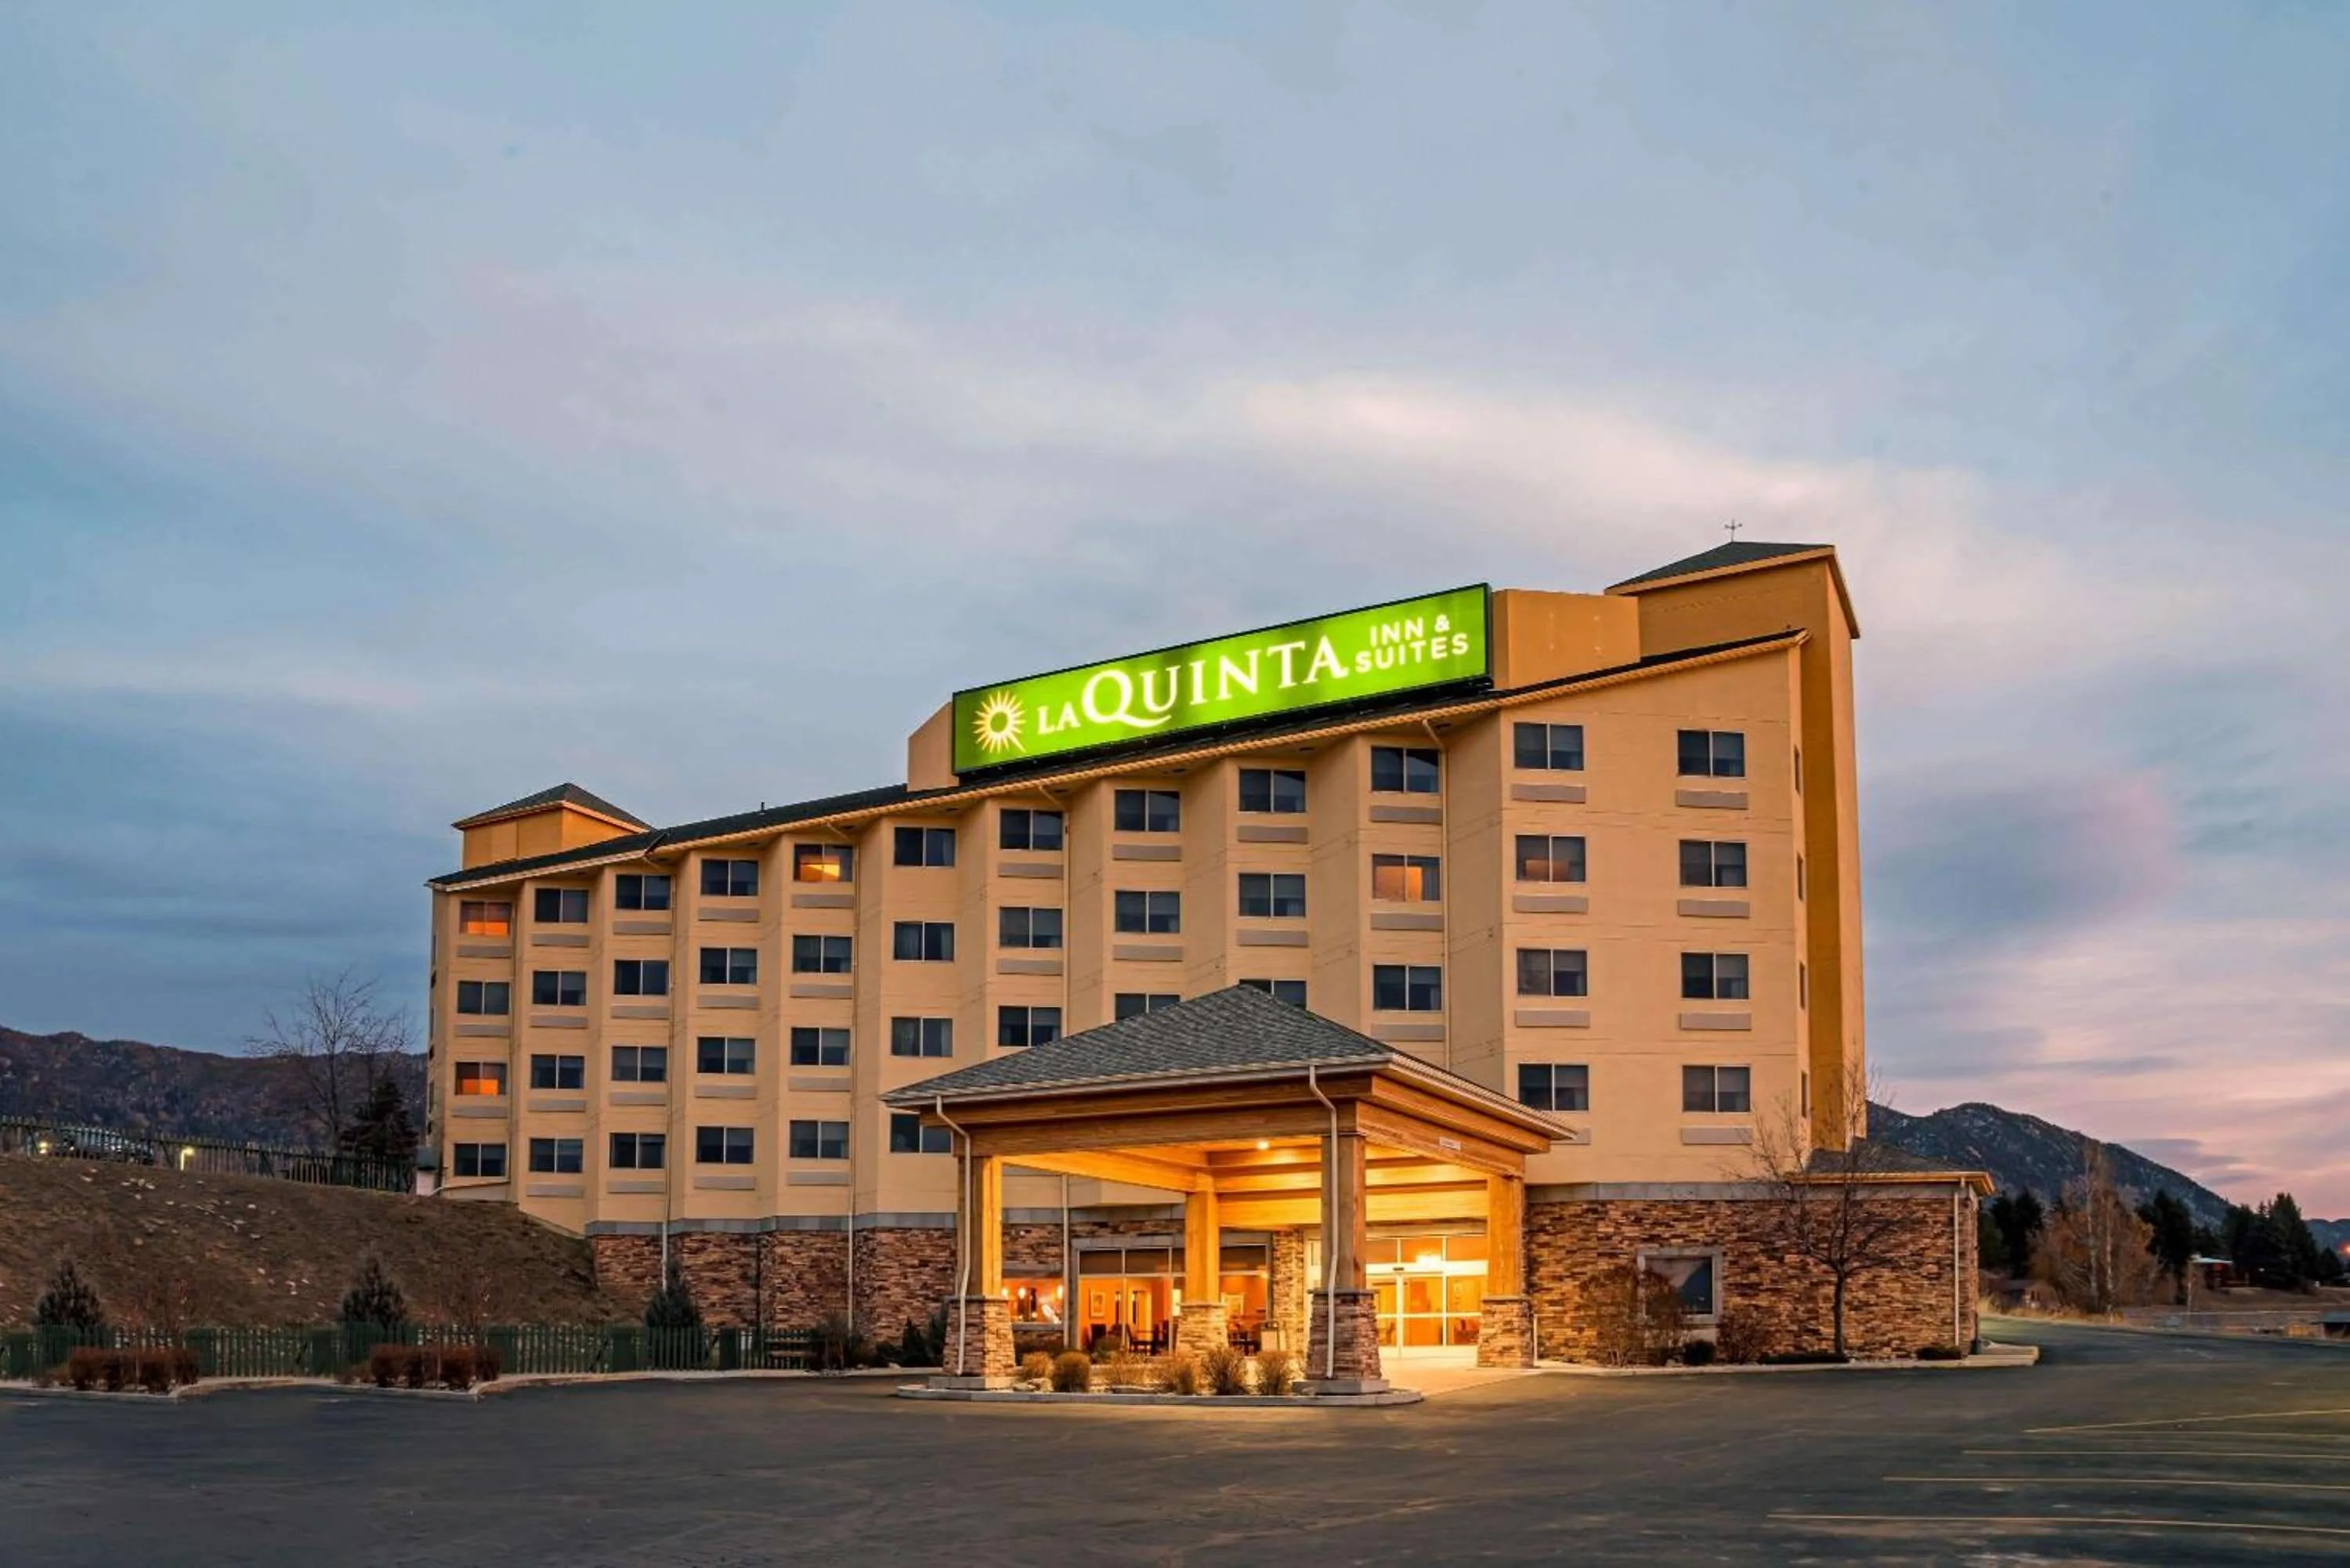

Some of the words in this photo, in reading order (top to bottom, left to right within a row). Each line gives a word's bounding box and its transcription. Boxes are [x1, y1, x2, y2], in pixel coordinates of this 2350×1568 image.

[1370, 617, 1423, 647] INN
[1434, 614, 1450, 633] &
[1355, 633, 1468, 673] SUITES
[1037, 702, 1081, 735] LA
[1082, 635, 1349, 728] QUINTA
